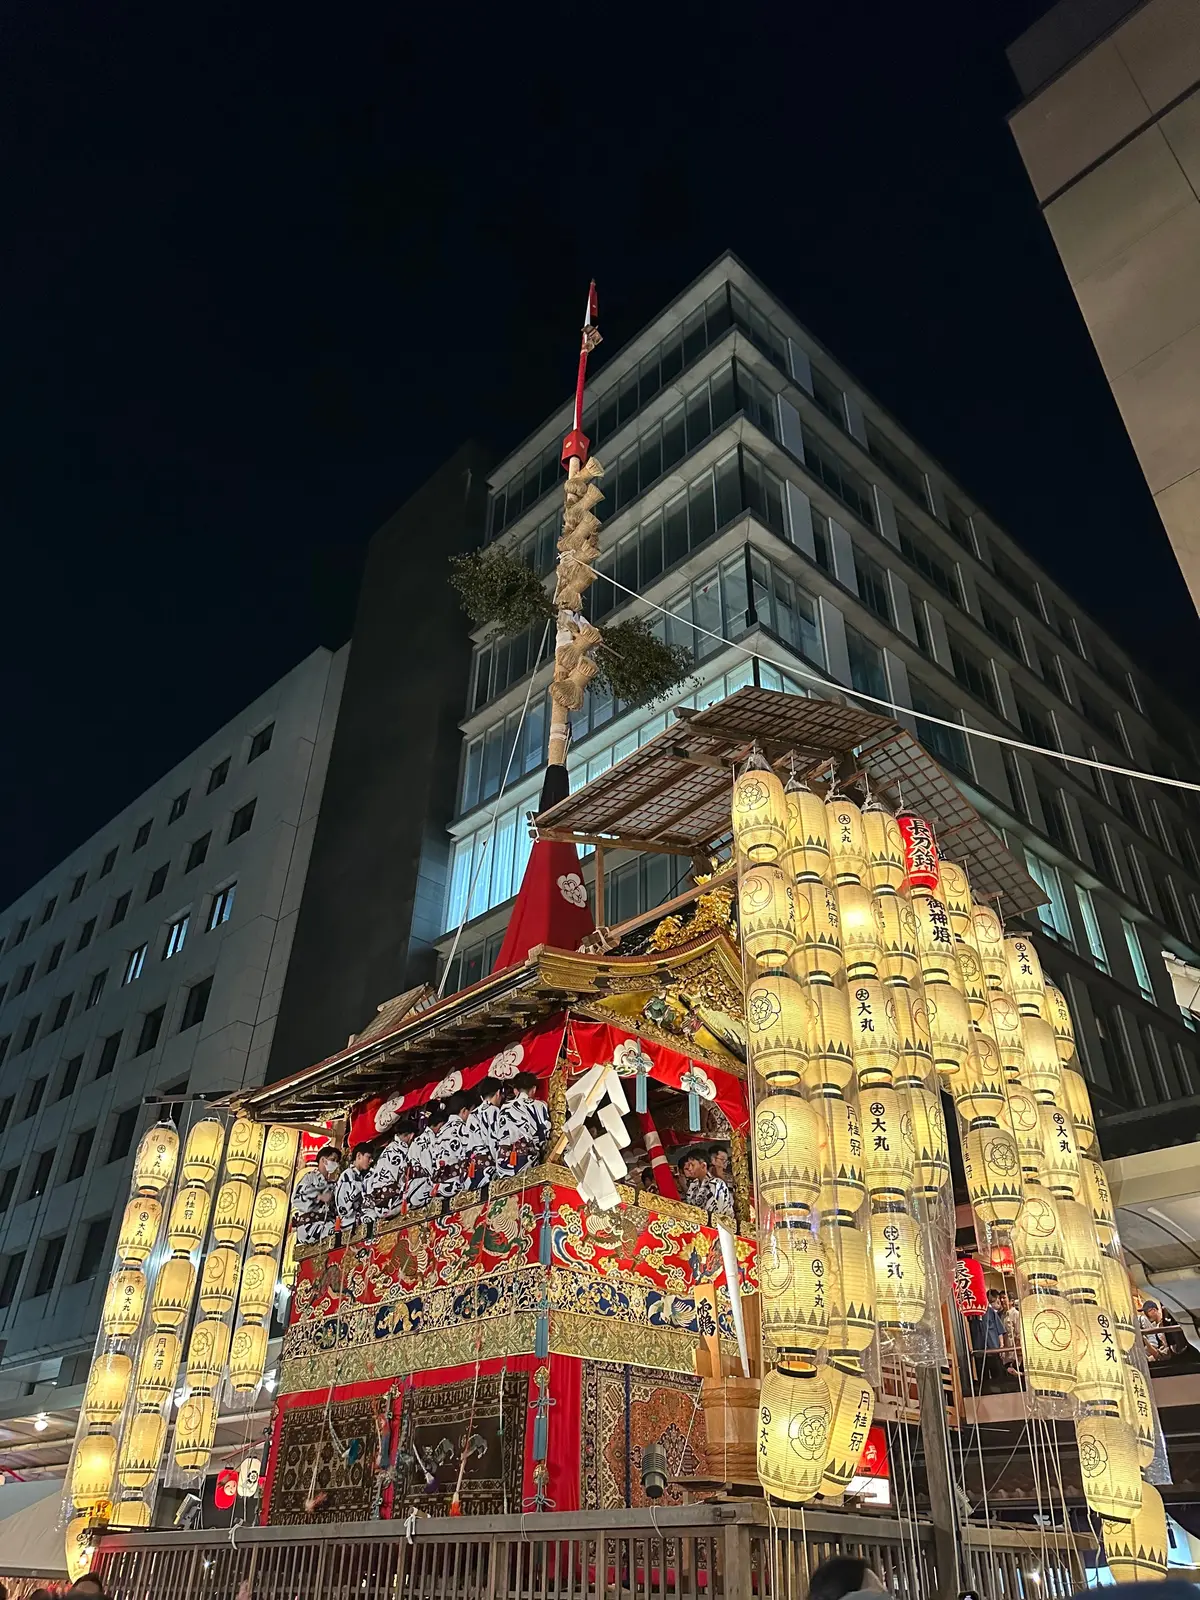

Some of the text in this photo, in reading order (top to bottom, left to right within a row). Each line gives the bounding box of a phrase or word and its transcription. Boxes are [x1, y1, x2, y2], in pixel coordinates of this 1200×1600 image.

[841, 826, 851, 843] 大丸
[907, 819, 936, 871] 長刀鉾
[1018, 953, 1033, 975] 大丸
[857, 1002, 875, 1033] 大丸
[846, 1105, 861, 1156] 月桂冠
[871, 1118, 890, 1151] 大丸
[1056, 1126, 1072, 1153] 大丸
[1093, 1163, 1109, 1202] 月桂冠
[184, 1191, 197, 1220] 月桂冠
[135, 1222, 146, 1237] 大丸
[885, 1242, 904, 1280] 大丸
[122, 1297, 132, 1312] 大丸
[814, 1280, 824, 1308] 大丸
[153, 1337, 167, 1371] 月桂冠
[1101, 1329, 1117, 1363] 大丸
[1131, 1370, 1148, 1418] 月桂冠
[848, 1390, 870, 1452] 月桂冠
[759, 1427, 769, 1456] 大丸
